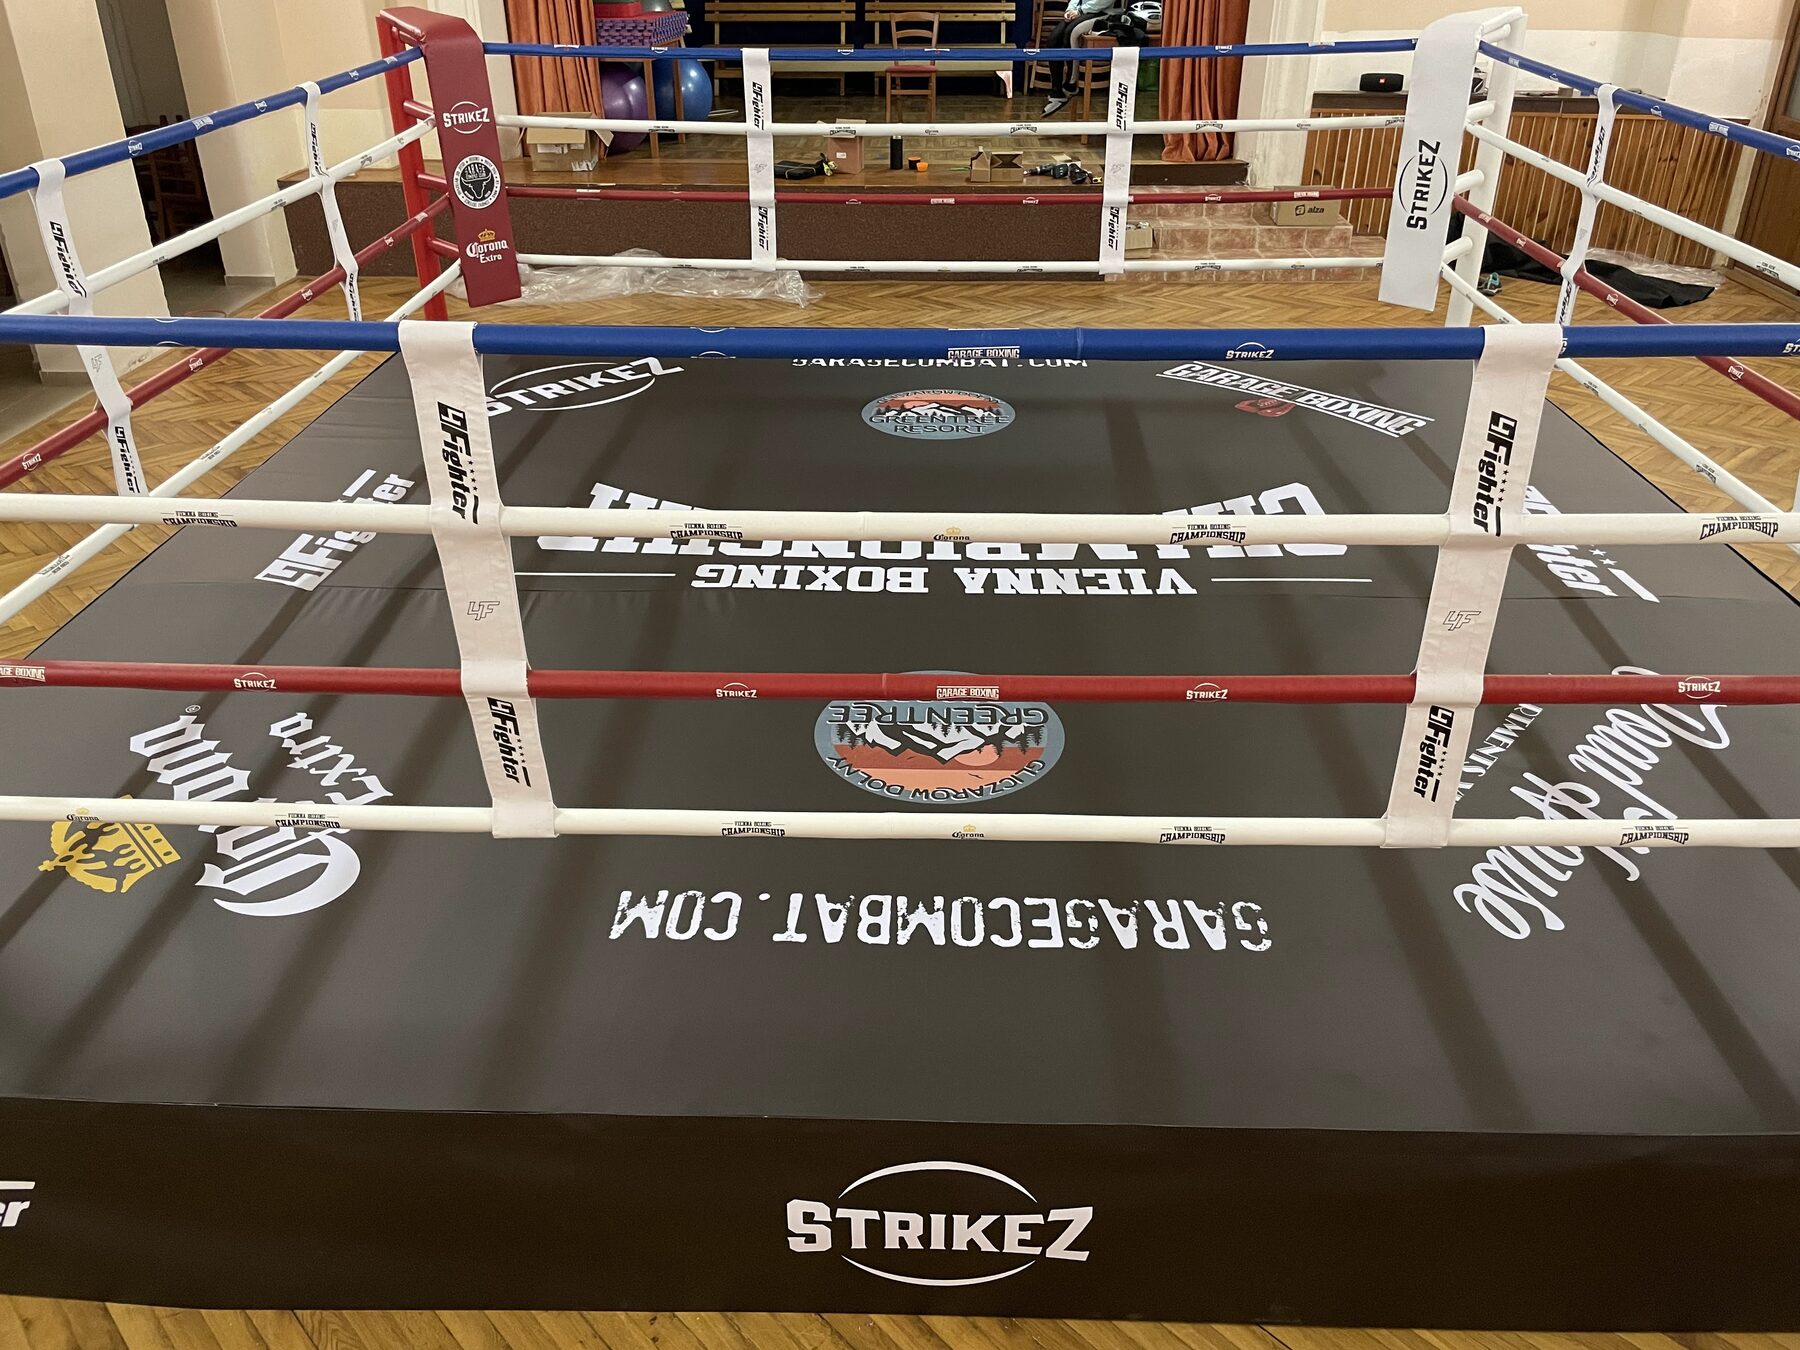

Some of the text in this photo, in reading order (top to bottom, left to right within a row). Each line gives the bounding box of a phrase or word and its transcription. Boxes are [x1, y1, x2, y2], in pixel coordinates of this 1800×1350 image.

[443, 107, 490, 128] STRIKEZ
[1406, 139, 1441, 230] STRIKEZ
[1307, 206, 1325, 214] alza
[466, 239, 509, 259] Corona
[479, 253, 502, 264] Extra
[1225, 350, 1274, 359] STRIKEZ
[486, 357, 685, 417] STRIKEZ
[1163, 363, 1427, 436] GARAGE BOXING
[869, 415, 1010, 426] GREENTREE
[894, 424, 988, 435] RESORT
[437, 401, 472, 520] 4Fighter
[1473, 410, 1518, 533] 4Fighter
[670, 530, 744, 540] CHAMPIONSHIP
[933, 533, 971, 541] Corona
[1169, 530, 1246, 545] CHAMPIONSHIP
[1699, 521, 1779, 541] CHAMPIONSHIP
[690, 563, 1198, 596] VIENNA BOXING
[15, 667, 46, 681] BOXING
[233, 678, 277, 690] STRIKEZ
[1678, 680, 1721, 693] STRIKEZ
[716, 688, 758, 699] STRIKEZ
[936, 687, 1000, 699] GARAGE BOXING
[1186, 688, 1228, 700] STRIKEZ
[827, 702, 1049, 727] GREENTREE
[486, 696, 520, 784] 4Fighter
[1413, 704, 1455, 799] 4Fighter
[826, 755, 1046, 802] GLICZAROW DOLNY
[129, 714, 362, 918] Coona
[275, 819, 340, 829] CHAMPIONSHIP
[721, 827, 786, 837] CHAMPIONSHIP
[952, 831, 985, 839] Corona
[1159, 832, 1226, 844] CHAMPIONSHIP
[1619, 832, 1689, 846] CHAMPIONSHIP
[607, 889, 1272, 953] GARAGECOMBAT.COM
[786, 1198, 1094, 1263] STRIKEZ
